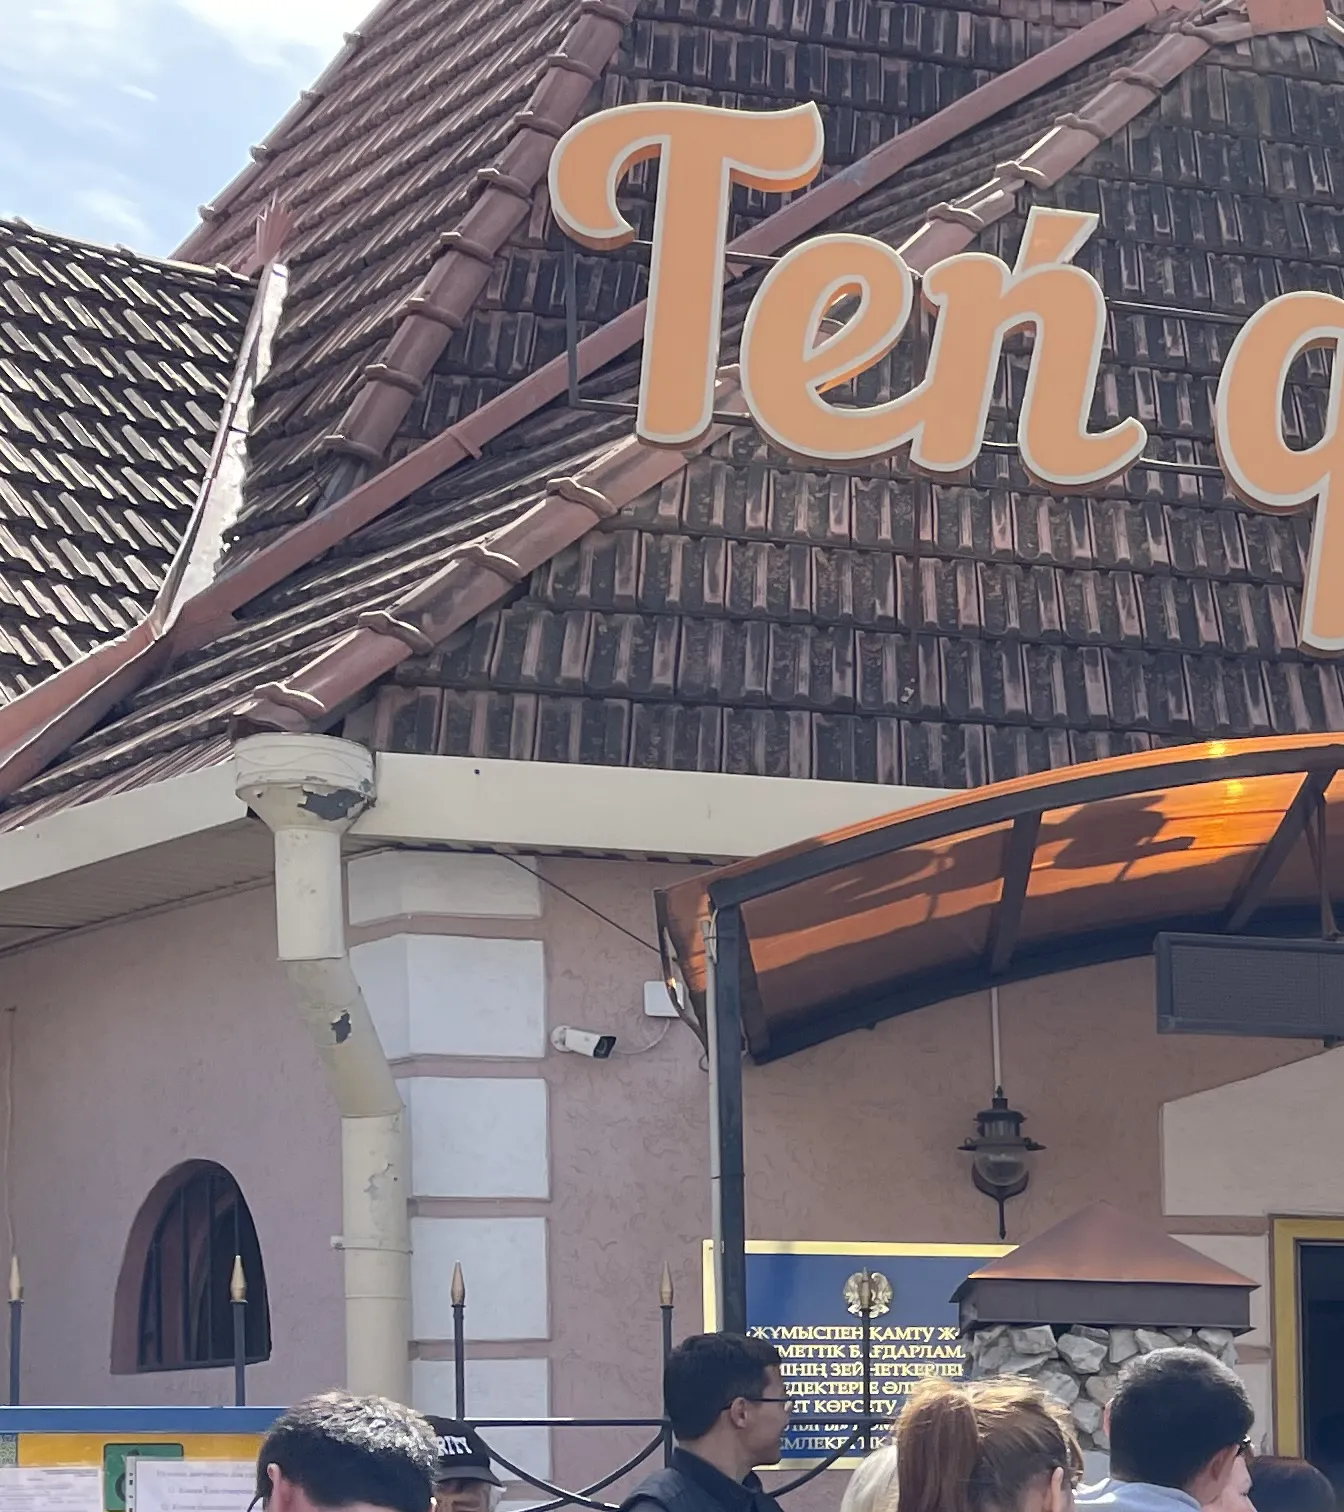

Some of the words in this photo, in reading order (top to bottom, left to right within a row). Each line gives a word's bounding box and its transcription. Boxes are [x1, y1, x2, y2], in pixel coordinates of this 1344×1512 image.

[548, 101, 1148, 489] Teń
[869, 1326, 935, 1342] ҚАМТУ
[814, 1399, 898, 1416] КӨРСТУ
